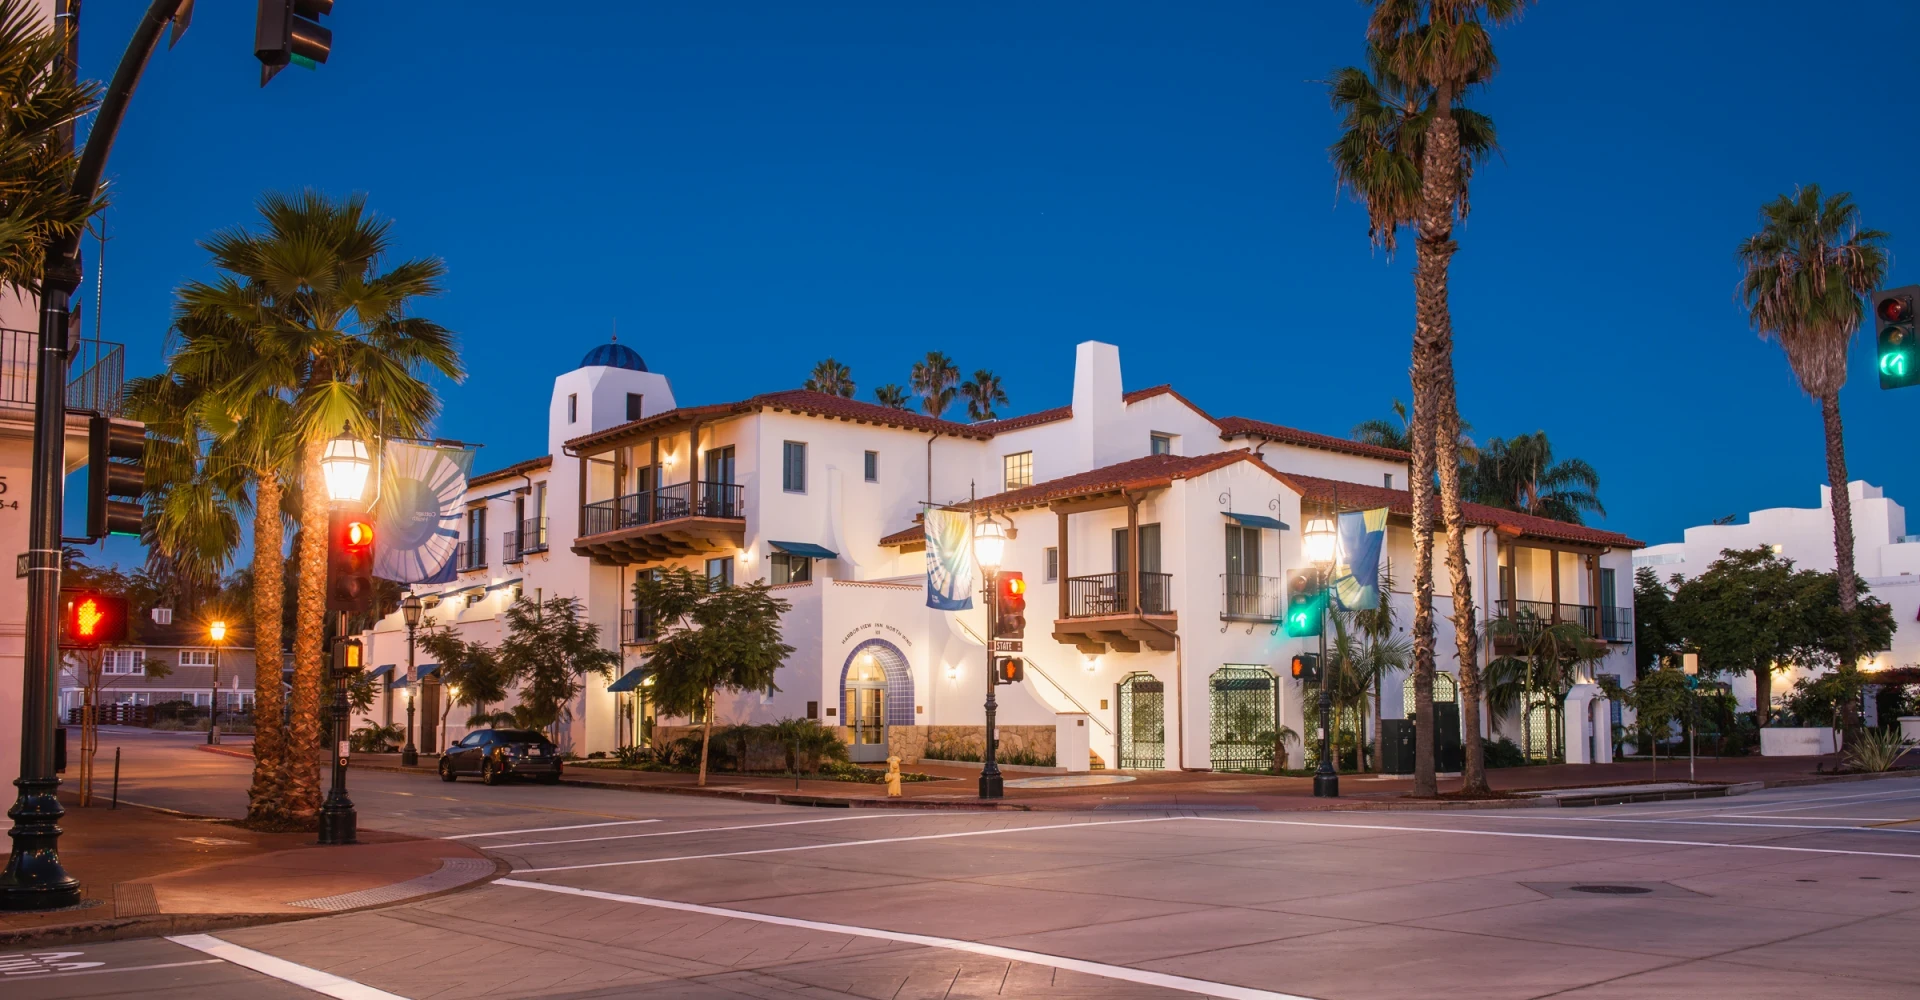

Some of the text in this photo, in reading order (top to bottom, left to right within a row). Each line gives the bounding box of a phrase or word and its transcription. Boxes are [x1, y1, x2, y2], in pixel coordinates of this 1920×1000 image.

[841, 627, 860, 644] HARBOR
[860, 623, 872, 631] VIEW
[885, 624, 902, 636] NORTH
[996, 641, 1012, 651] STATE
